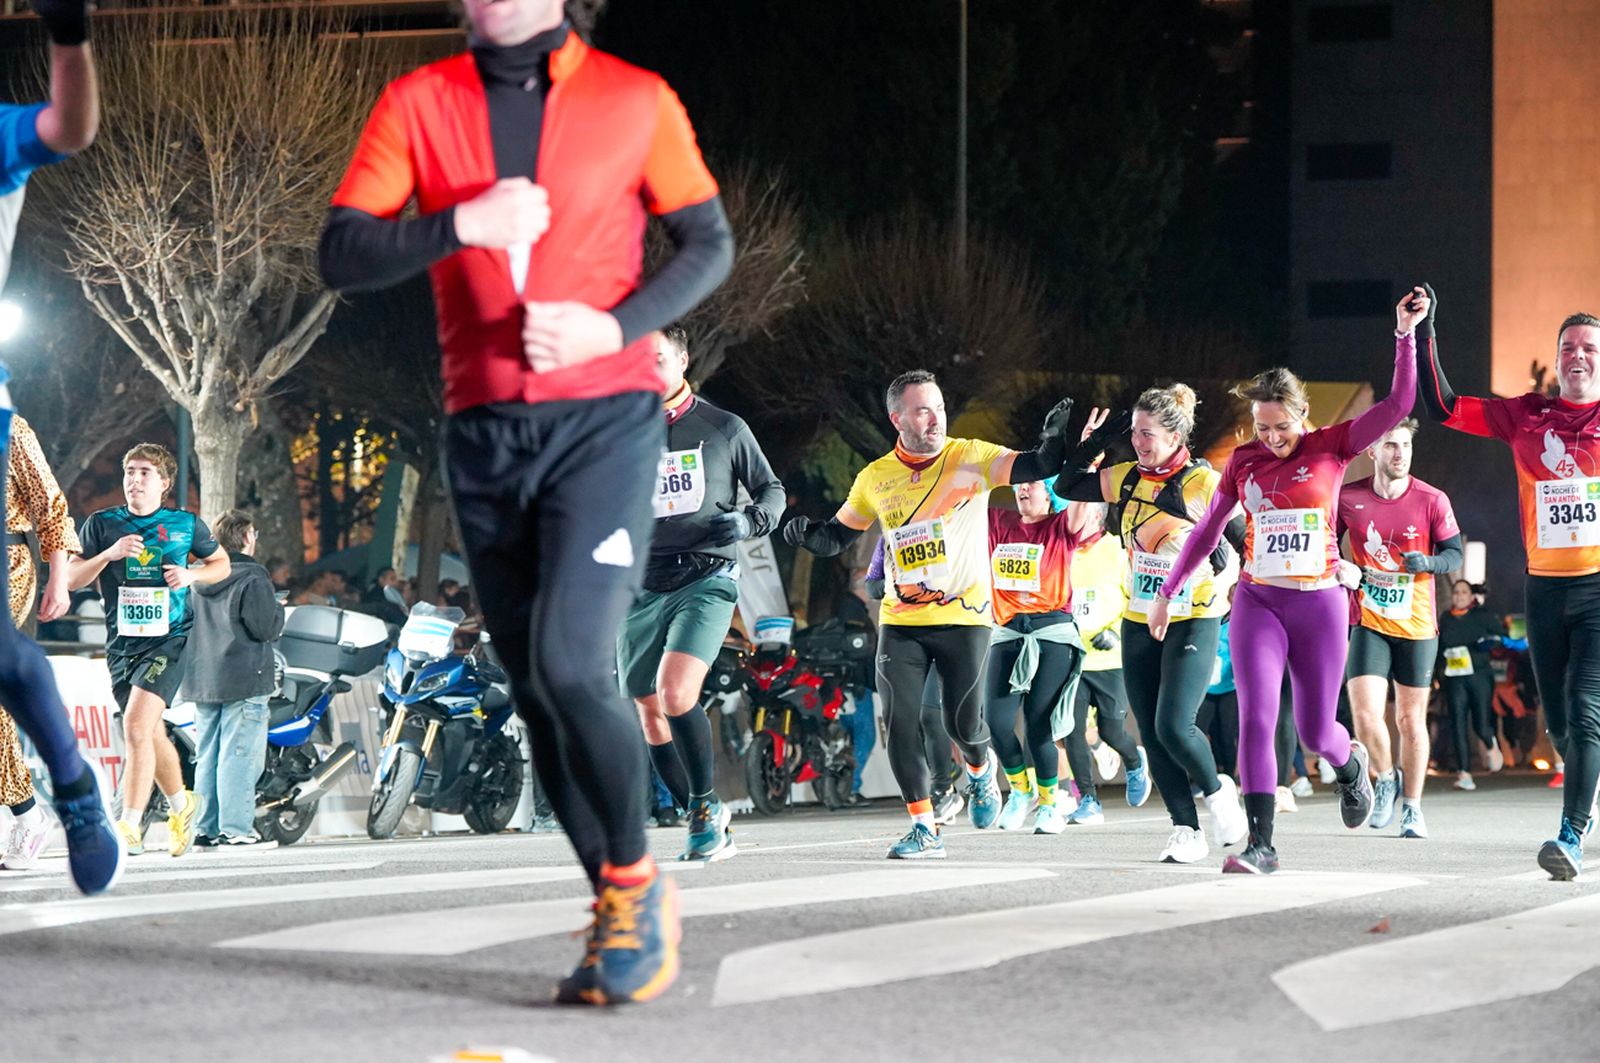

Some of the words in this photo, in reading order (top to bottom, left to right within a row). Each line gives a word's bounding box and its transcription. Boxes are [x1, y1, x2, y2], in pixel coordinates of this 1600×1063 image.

[1555, 459, 1575, 478] 43
[1551, 487, 1572, 495] NOCHE
[1544, 496, 1560, 504] SAN
[1267, 516, 1288, 524] NOCHE
[1549, 502, 1597, 525] 3343
[902, 529, 918, 539] NOCHE
[1261, 525, 1275, 534] SAN
[897, 541, 908, 549] SAN
[1267, 533, 1311, 553] 2947
[900, 539, 946, 566] 13934
[1374, 548, 1388, 562] 43
[999, 558, 1030, 575] 5823
[1367, 585, 1405, 603] 12937
[122, 605, 163, 620] 13366
[64, 705, 110, 748] AN
